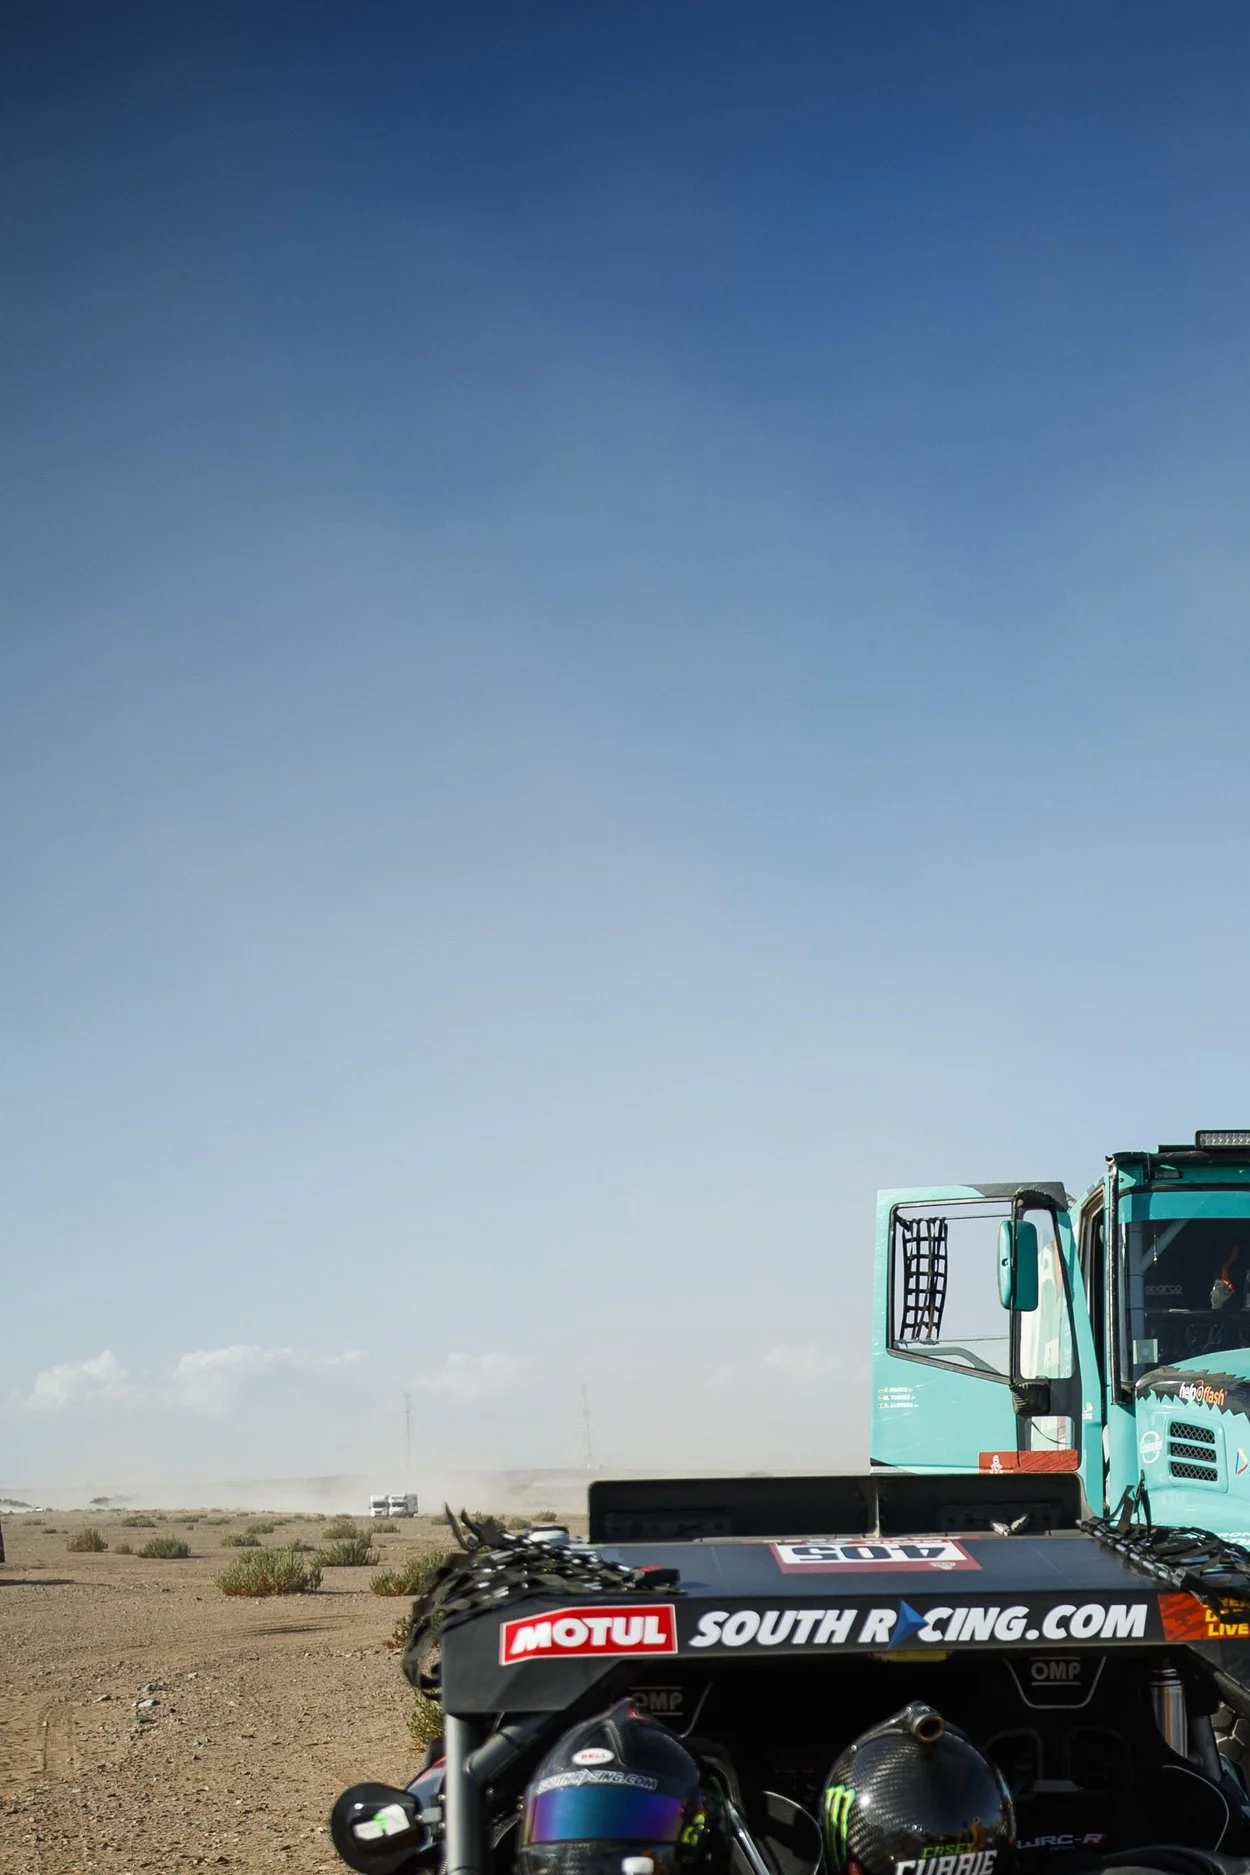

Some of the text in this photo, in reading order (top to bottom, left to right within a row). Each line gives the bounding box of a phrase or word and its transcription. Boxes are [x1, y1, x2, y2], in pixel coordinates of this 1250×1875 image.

[791, 1544, 946, 1562] 405
[510, 1616, 668, 1655] MOTUL
[689, 1608, 857, 1647] SOUTH
[1207, 1623, 1249, 1637] LIVE
[1031, 1661, 1081, 1681] OMP
[632, 1691, 684, 1711] OMP
[921, 1842, 975, 1859] CASEY
